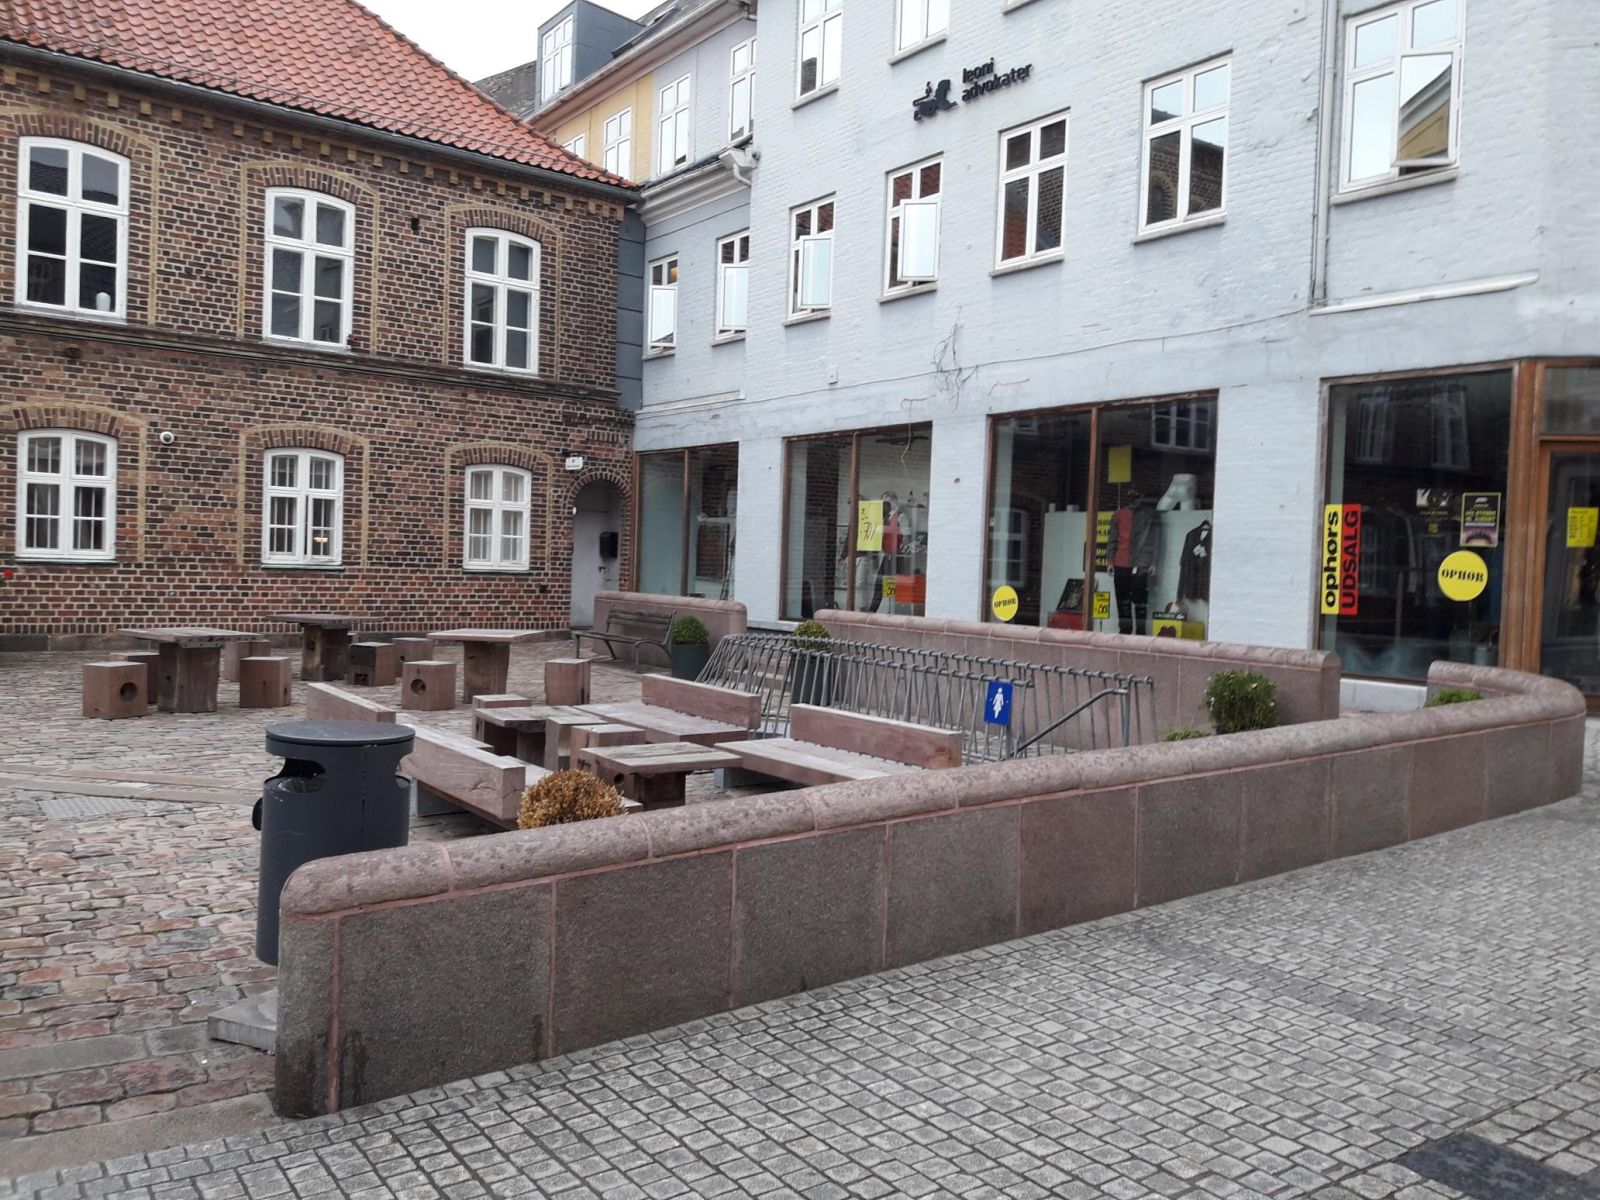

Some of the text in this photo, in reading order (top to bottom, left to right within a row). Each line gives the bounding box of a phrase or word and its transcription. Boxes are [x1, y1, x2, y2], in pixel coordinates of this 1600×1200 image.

[961, 63, 1032, 102] advokater
[962, 57, 994, 83] leoni
[1323, 510, 1340, 608] ophors
[1341, 510, 1359, 609] UDSALG
[1441, 568, 1484, 582] OPHOR
